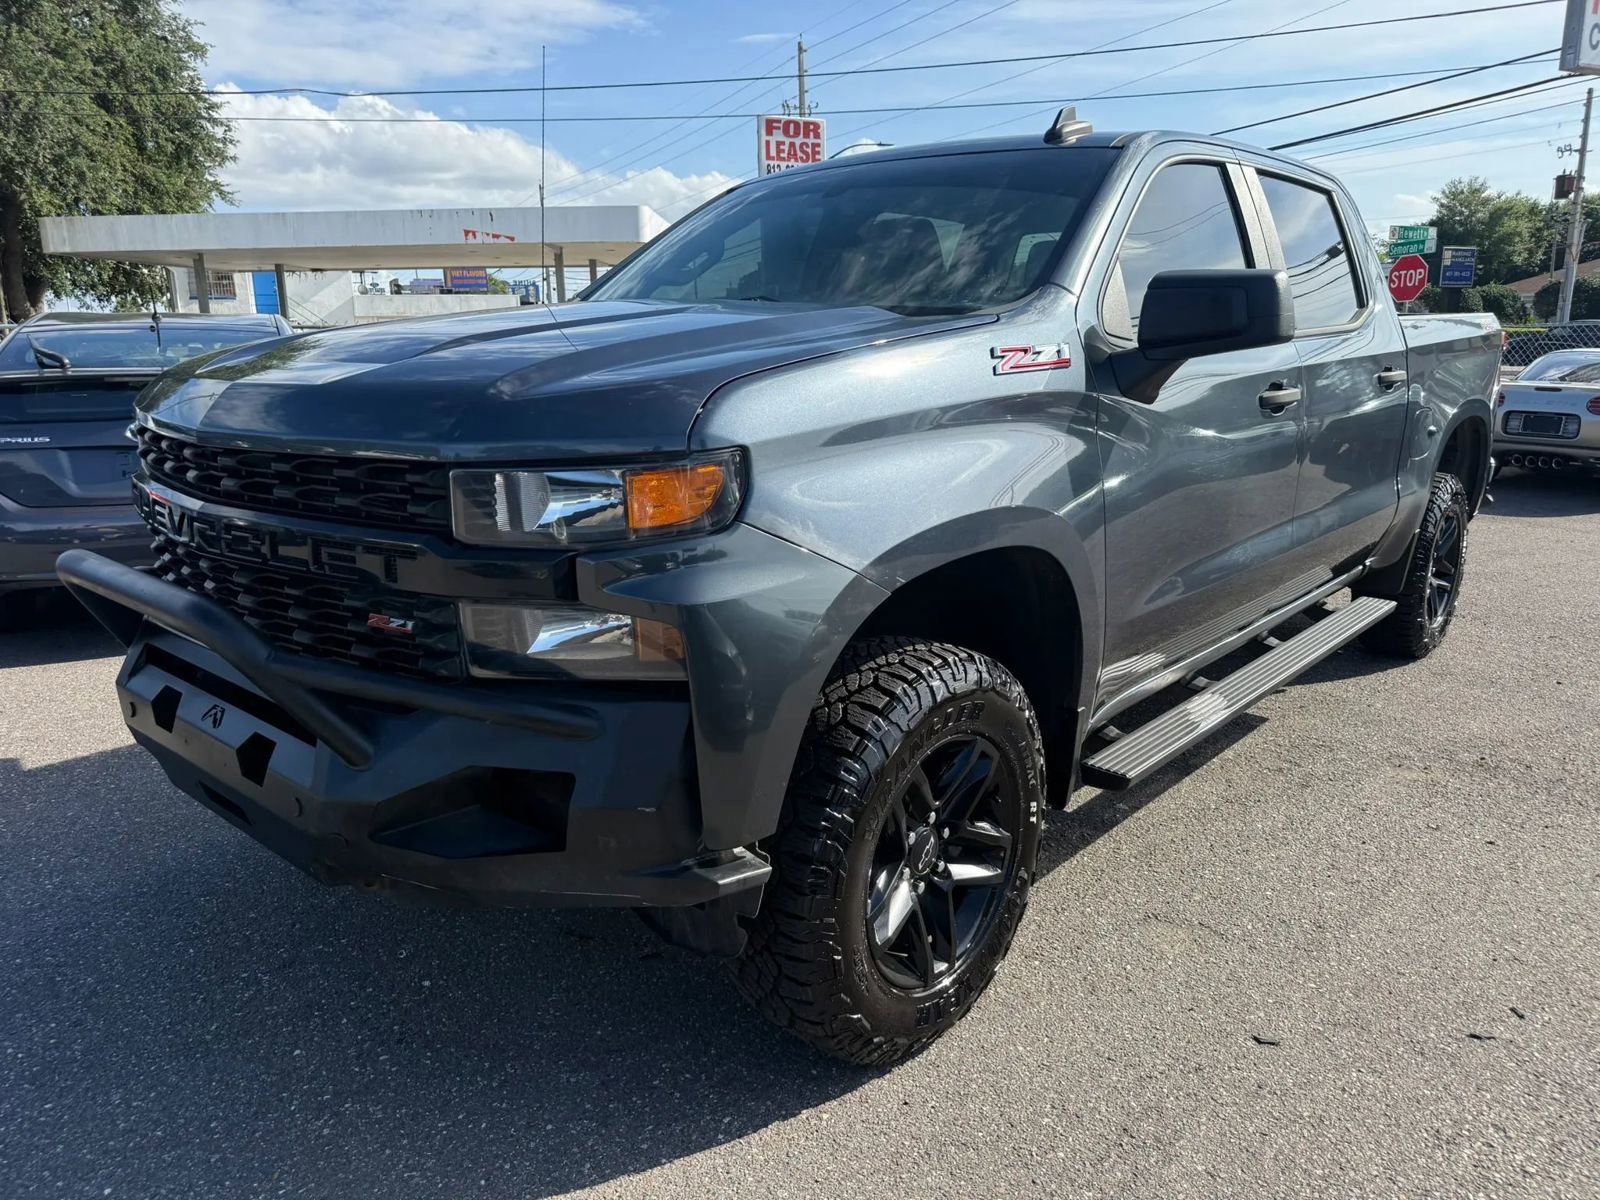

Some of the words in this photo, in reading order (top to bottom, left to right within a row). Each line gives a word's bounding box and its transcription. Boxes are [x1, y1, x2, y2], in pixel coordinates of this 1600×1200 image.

[765, 118, 821, 140] FOR
[765, 140, 821, 163] LEASE
[1390, 244, 1417, 255] Semoran
[1390, 269, 1425, 288] STOP
[990, 343, 1071, 376] Z71
